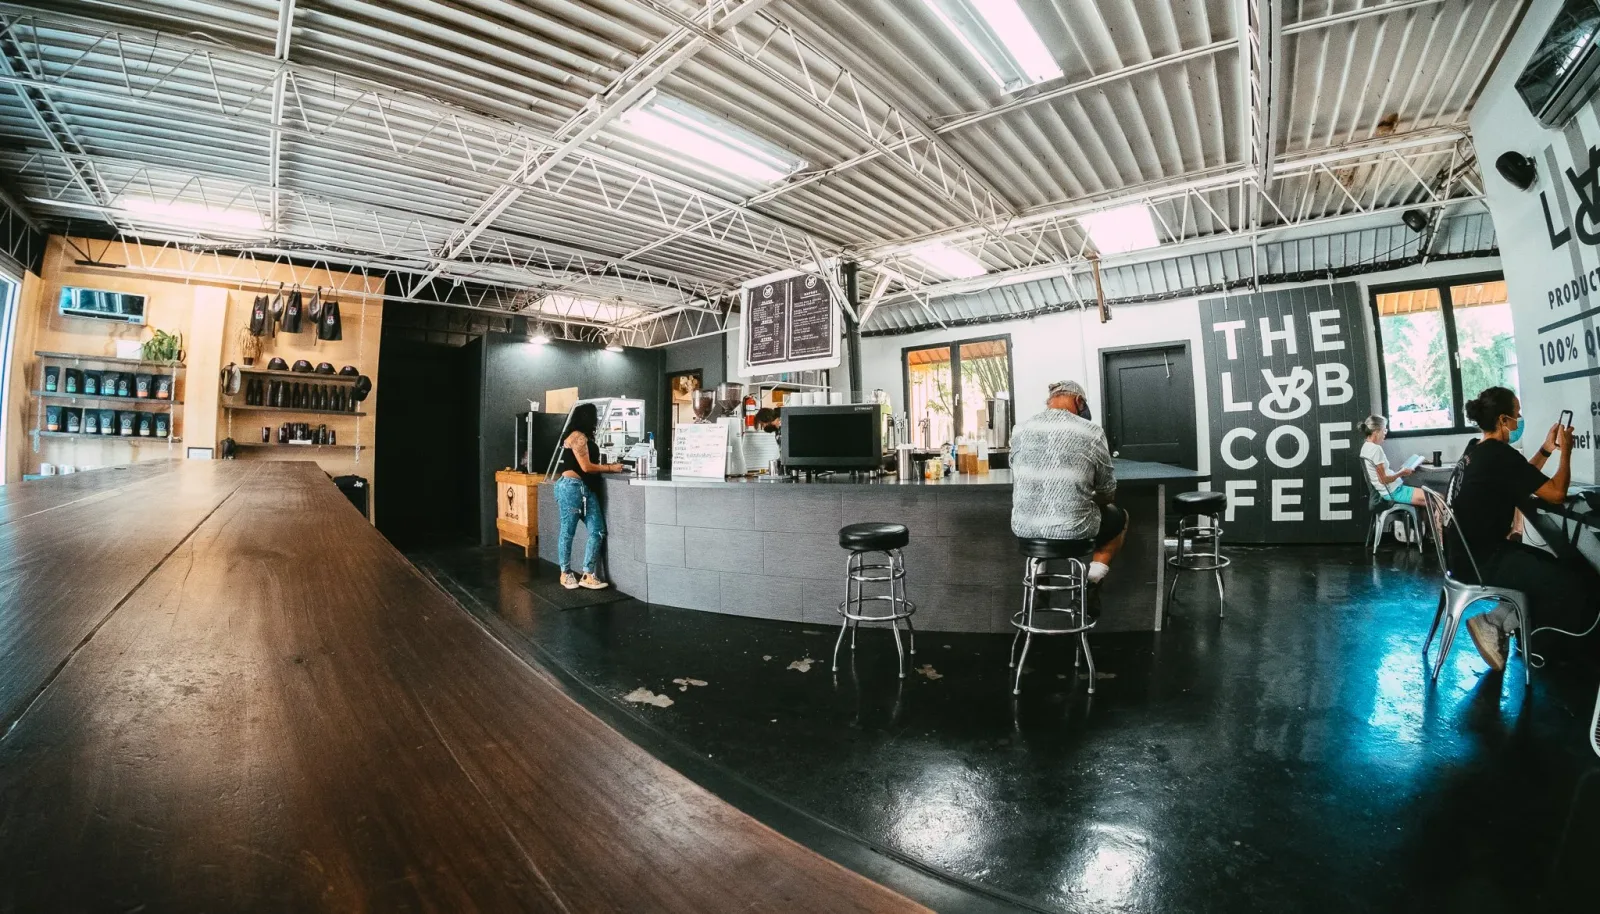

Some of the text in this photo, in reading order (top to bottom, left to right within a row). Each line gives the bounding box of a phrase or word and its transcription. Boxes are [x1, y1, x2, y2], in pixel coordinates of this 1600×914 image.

[1213, 309, 1346, 360] THE
[1539, 333, 1578, 366] 100%
[1220, 421, 1353, 470] COF
[1224, 476, 1353, 522] FEE
